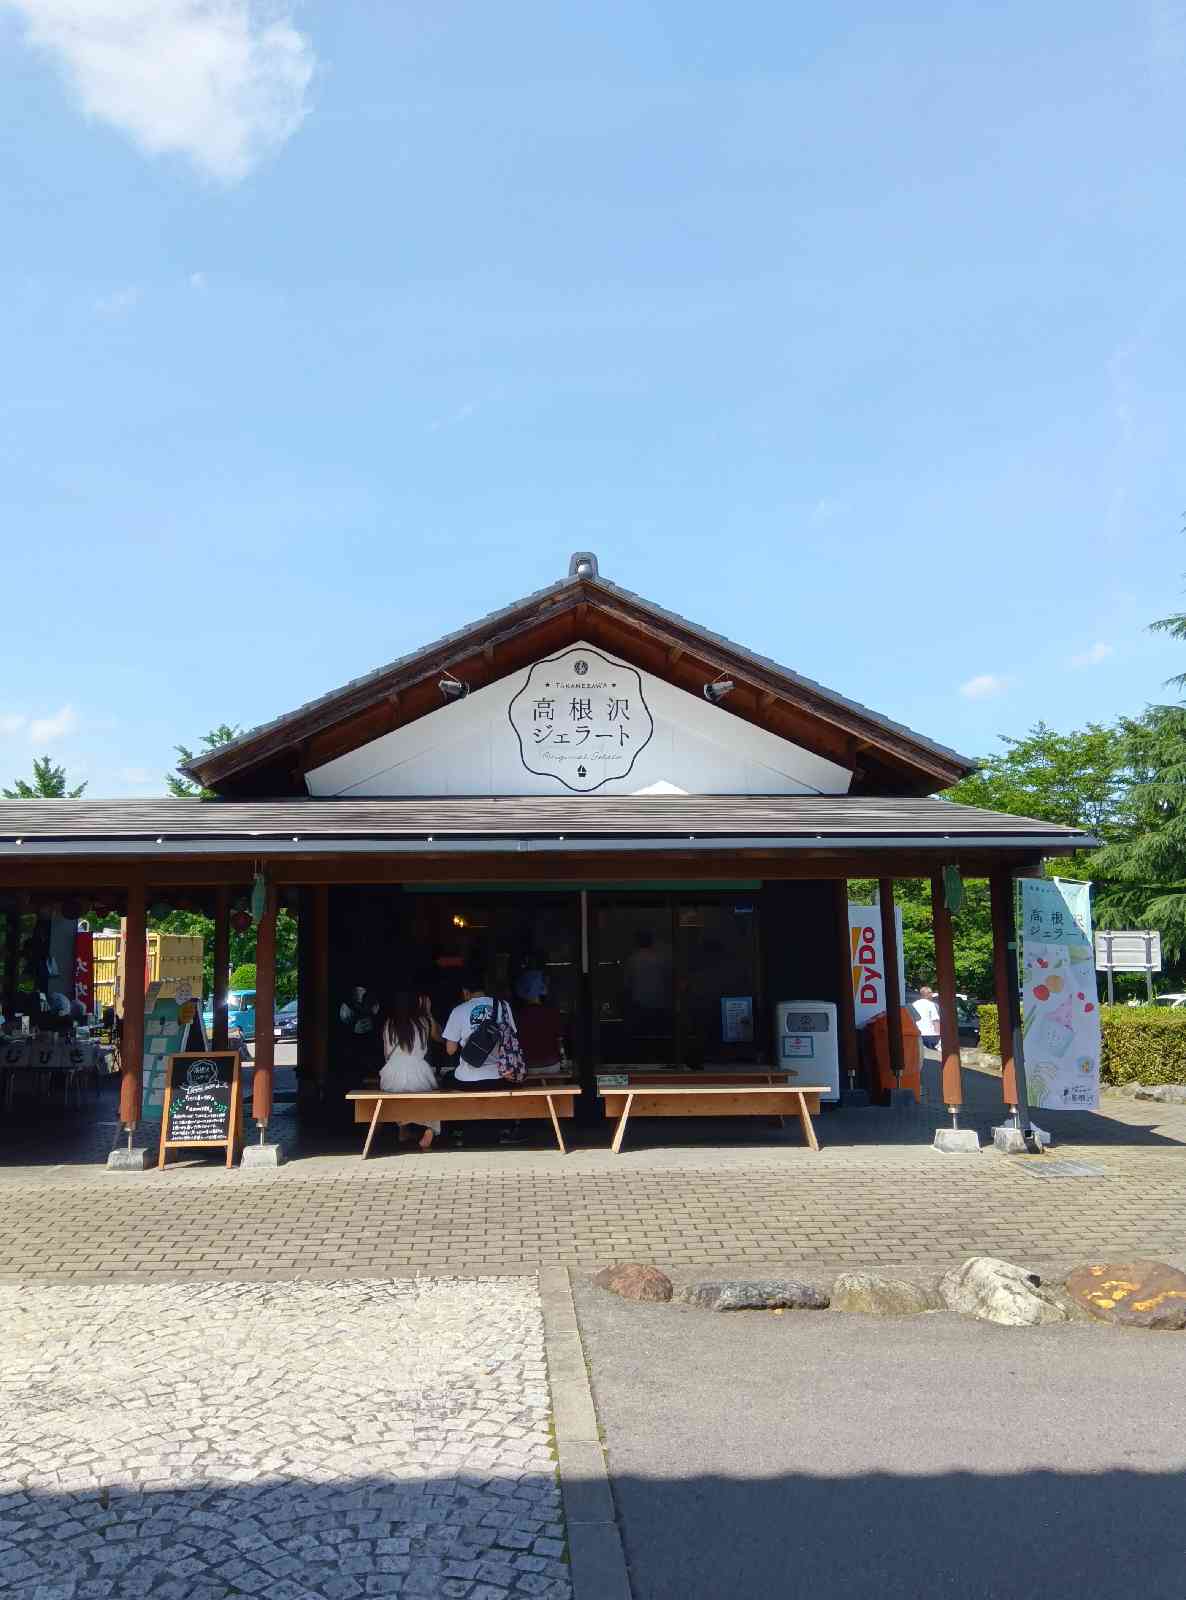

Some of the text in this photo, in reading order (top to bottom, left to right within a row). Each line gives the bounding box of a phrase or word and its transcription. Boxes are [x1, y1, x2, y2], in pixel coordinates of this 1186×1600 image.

[532, 697, 630, 721] 高根沢
[532, 724, 630, 747] ジェラート
[859, 927, 881, 1004] DyDo
